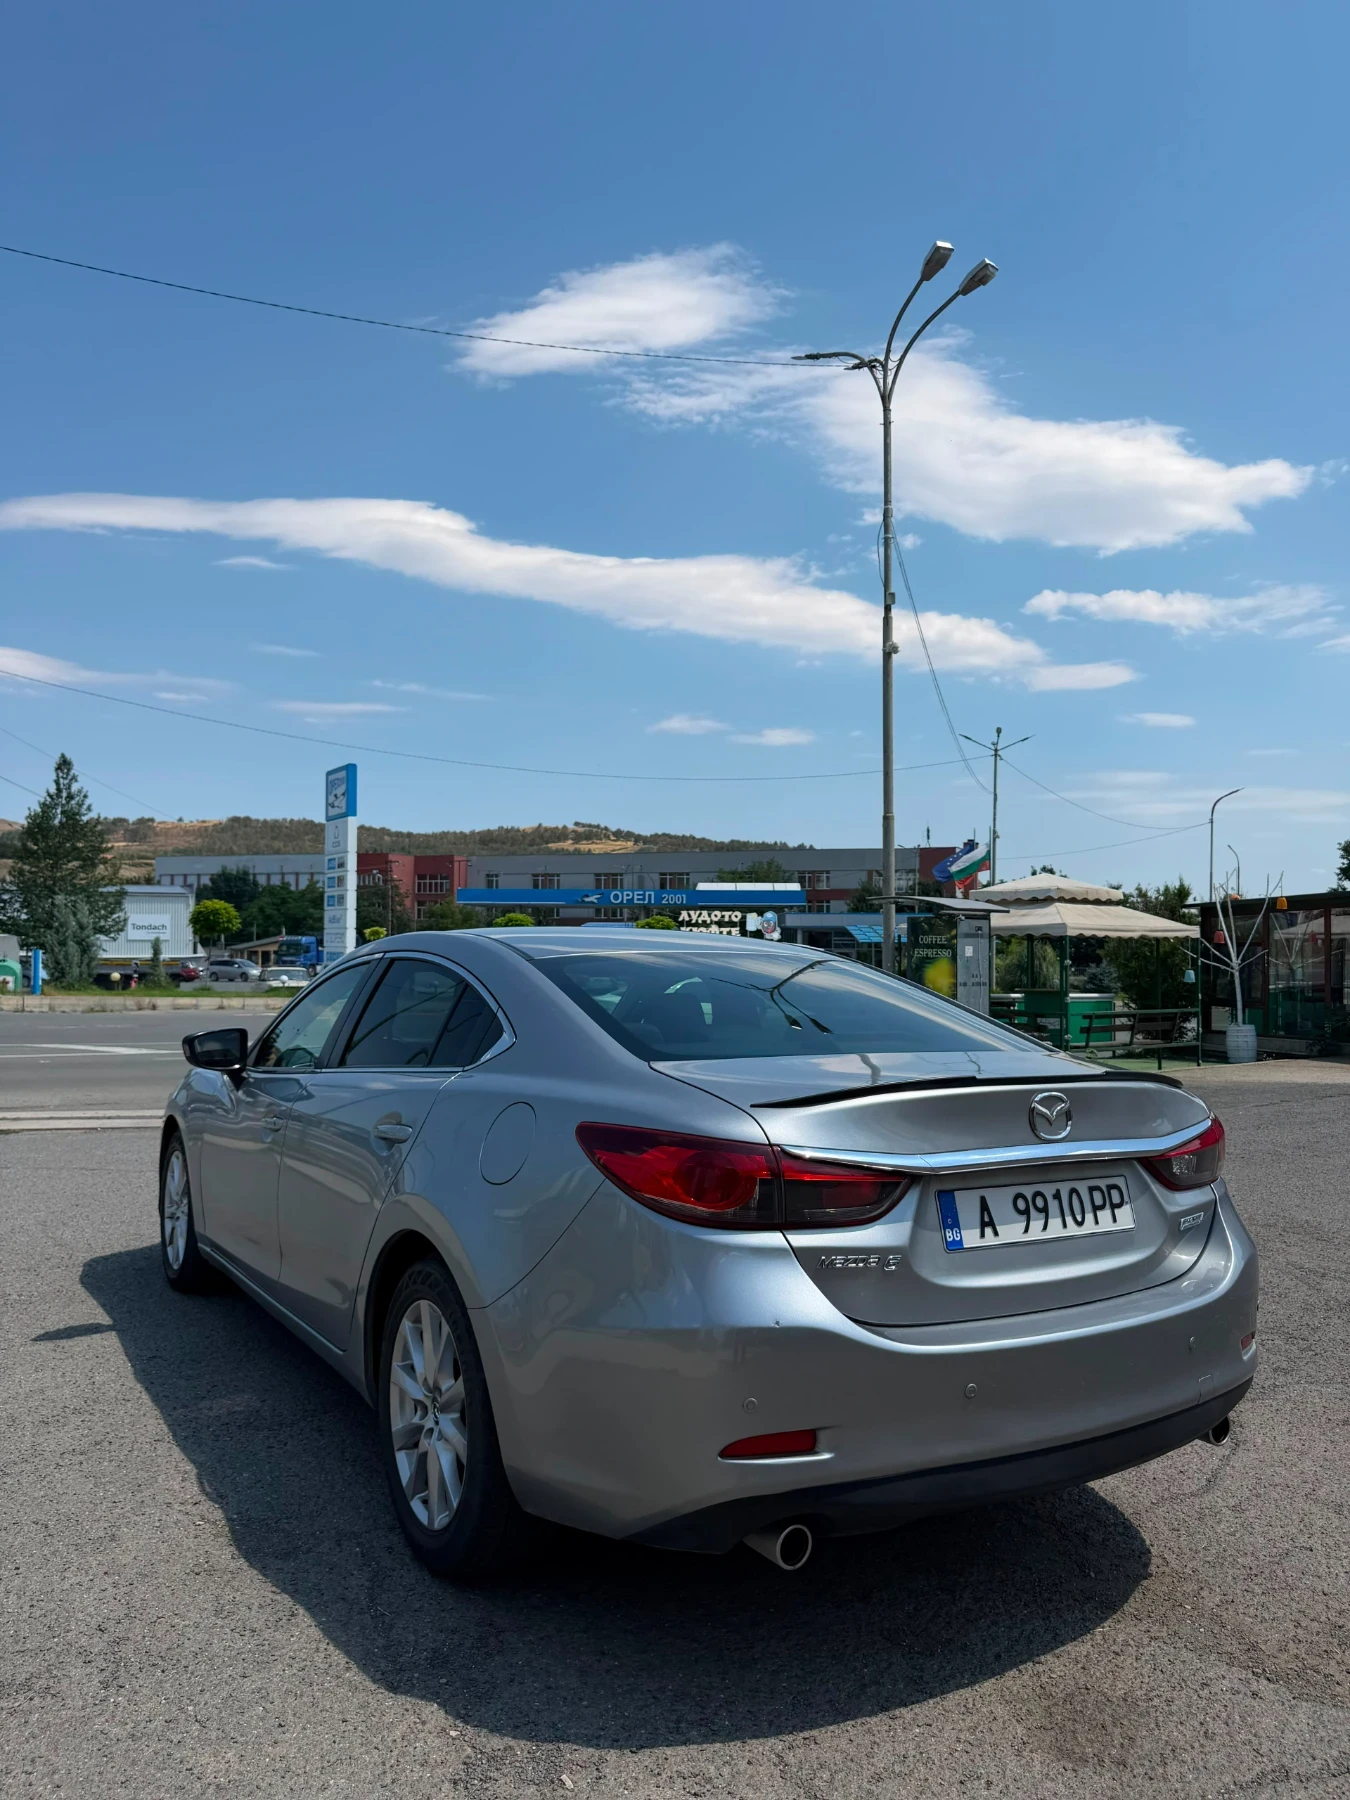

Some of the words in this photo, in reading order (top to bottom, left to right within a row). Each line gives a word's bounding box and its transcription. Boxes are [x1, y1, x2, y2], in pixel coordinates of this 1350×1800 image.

[609, 891, 655, 904] ОРЕЛ
[661, 894, 687, 904] 2001
[678, 910, 742, 924] ЛУДОТО
[918, 935, 948, 944] COFFEE
[914, 948, 952, 958] ESPRESSO
[979, 1195, 1000, 1239] A
[945, 1228, 961, 1242] BG
[883, 1255, 902, 1271] 6
